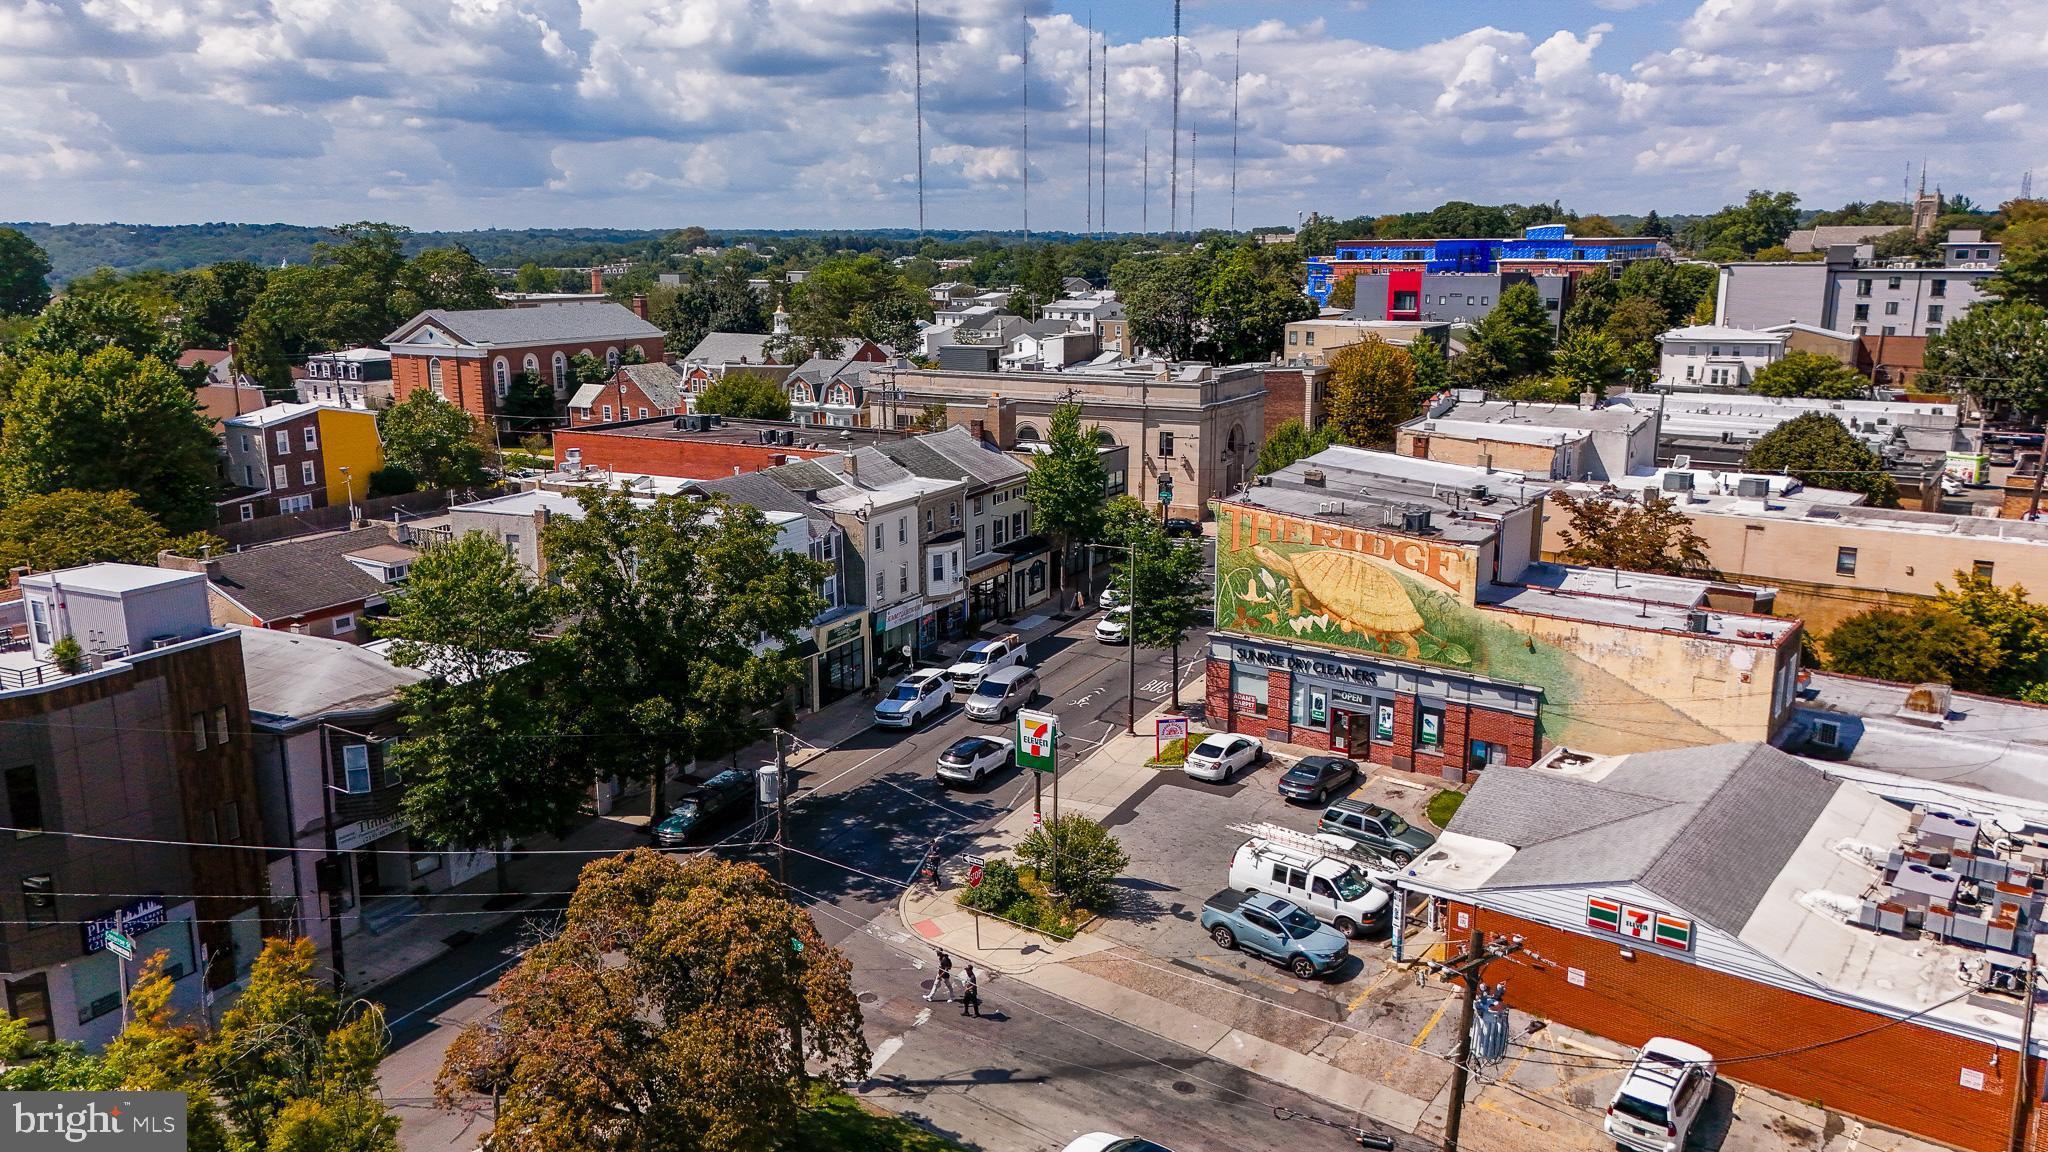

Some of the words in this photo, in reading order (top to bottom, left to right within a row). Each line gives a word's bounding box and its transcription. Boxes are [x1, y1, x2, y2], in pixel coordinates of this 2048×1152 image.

[1222, 507, 1305, 552] THE
[1311, 525, 1465, 593] RIDGE
[1237, 649, 1284, 666] SUNRISE
[1287, 655, 1313, 672] DRY
[1313, 661, 1377, 683] CLEANERS
[1140, 680, 1173, 693] BUS
[1233, 692, 1256, 702] ADAM'S
[1341, 692, 1363, 703] OPEN
[1233, 700, 1255, 709] CARPET
[1025, 719, 1047, 756] 7
[970, 871, 982, 881] STOP
[1627, 909, 1649, 937] 7
